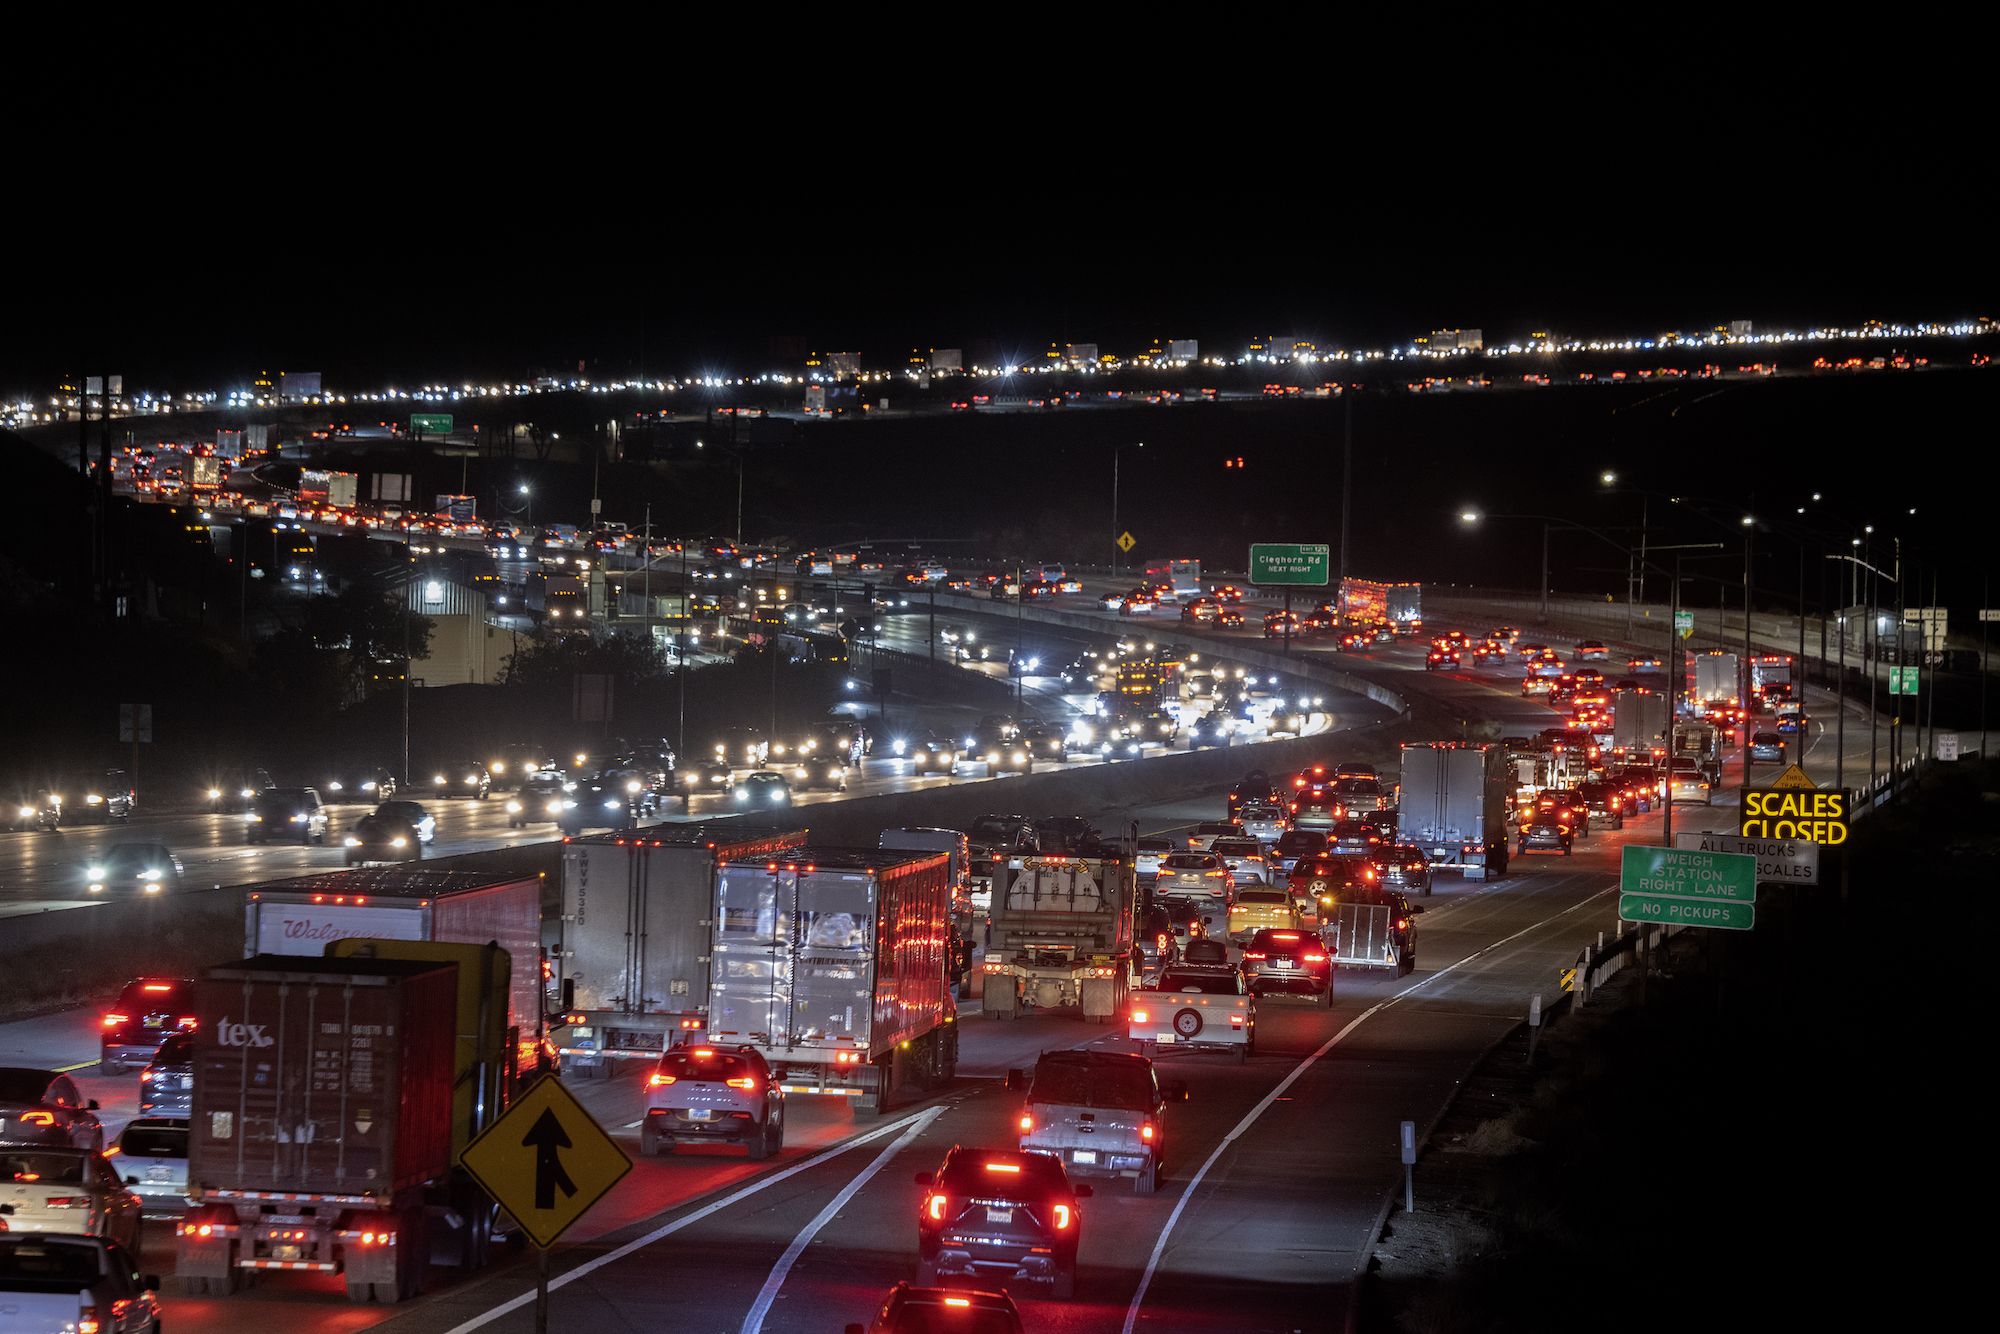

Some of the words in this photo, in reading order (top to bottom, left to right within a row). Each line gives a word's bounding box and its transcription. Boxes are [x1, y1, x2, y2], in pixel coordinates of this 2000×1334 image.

[1259, 555, 1303, 565] Cleghorn
[1307, 556, 1320, 564] Rd
[1745, 792, 1843, 818] SCALES
[1700, 840, 1729, 853] ALL
[1738, 842, 1796, 857] TRUCKS
[1666, 853, 1713, 868] WEIGH
[1656, 867, 1723, 881] STATION
[1639, 878, 1684, 892] RIGHT
[1695, 882, 1737, 896] LANE
[1642, 903, 1661, 915] NO
[1670, 905, 1730, 920] PICKUPS
